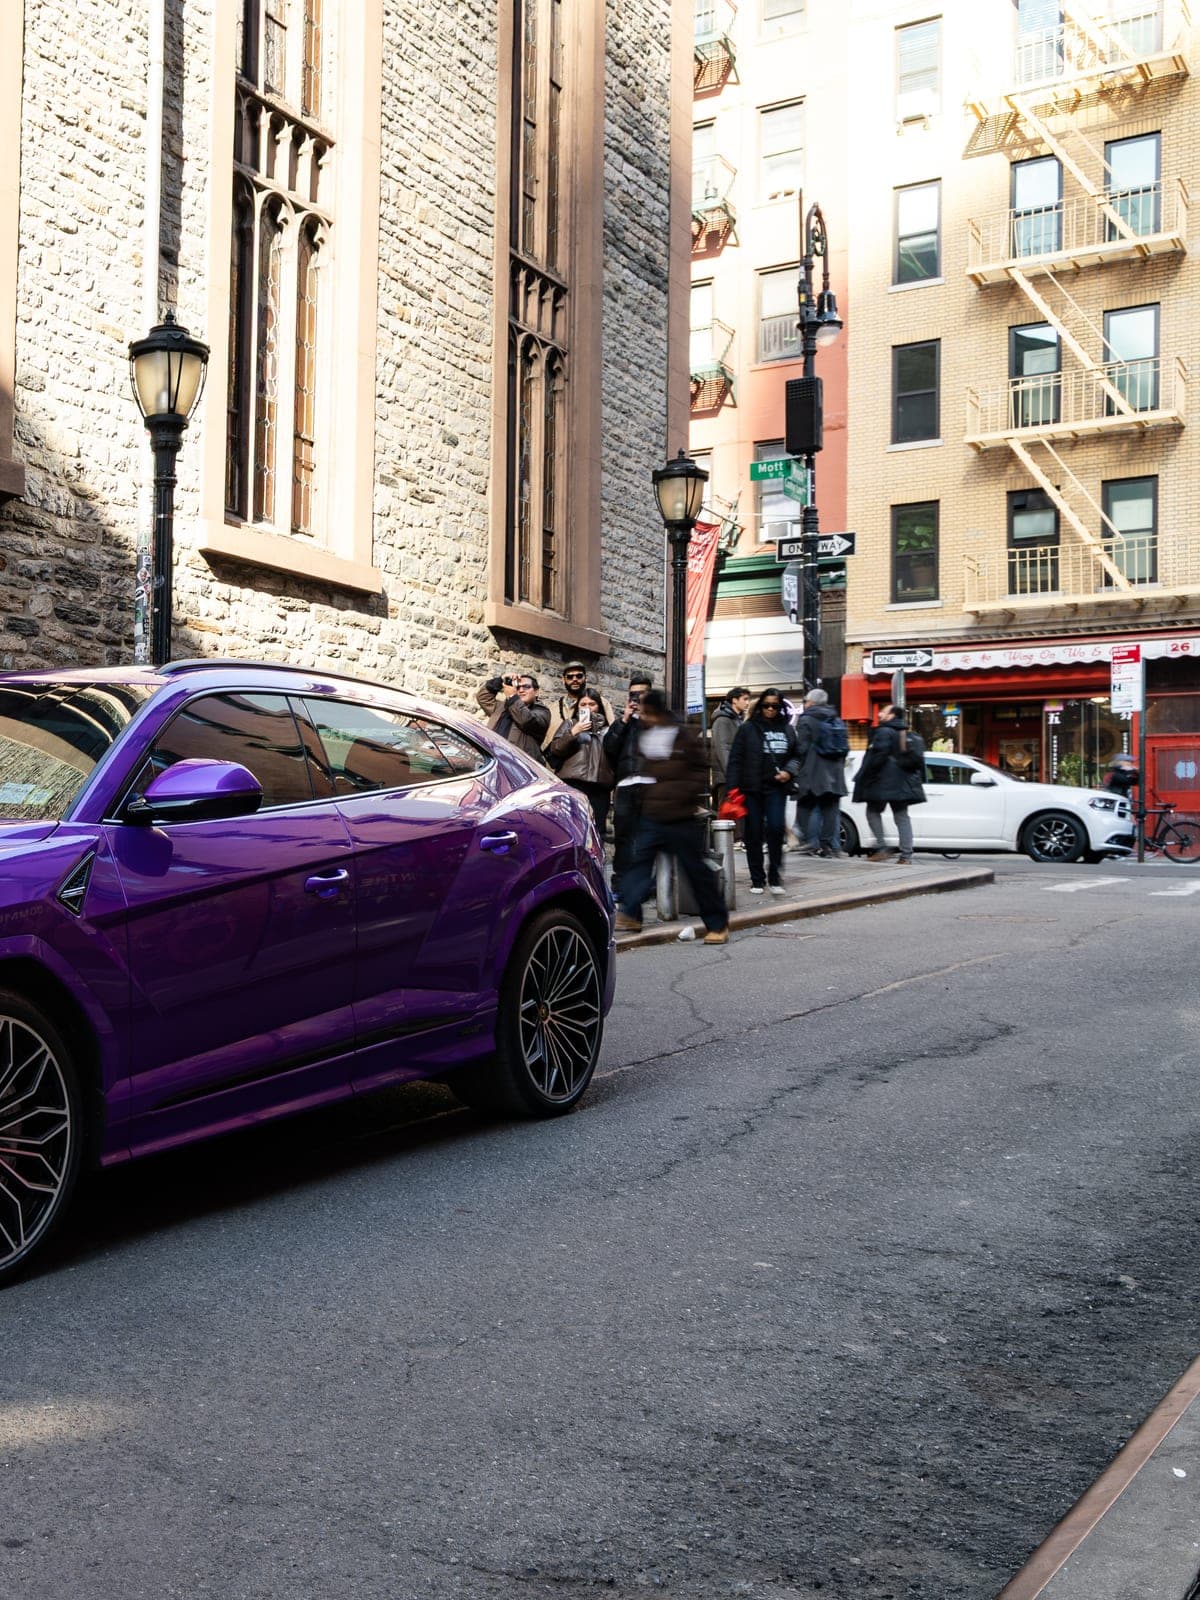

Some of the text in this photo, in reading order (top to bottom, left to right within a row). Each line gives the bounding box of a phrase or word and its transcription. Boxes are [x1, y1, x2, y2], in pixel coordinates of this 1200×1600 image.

[758, 462, 783, 473] Mott
[788, 541, 843, 553] ON WAY
[1170, 642, 1190, 652] 26
[877, 654, 926, 664] ONE WAY
[1003, 650, 1033, 665] Wing
[1040, 650, 1056, 659] On
